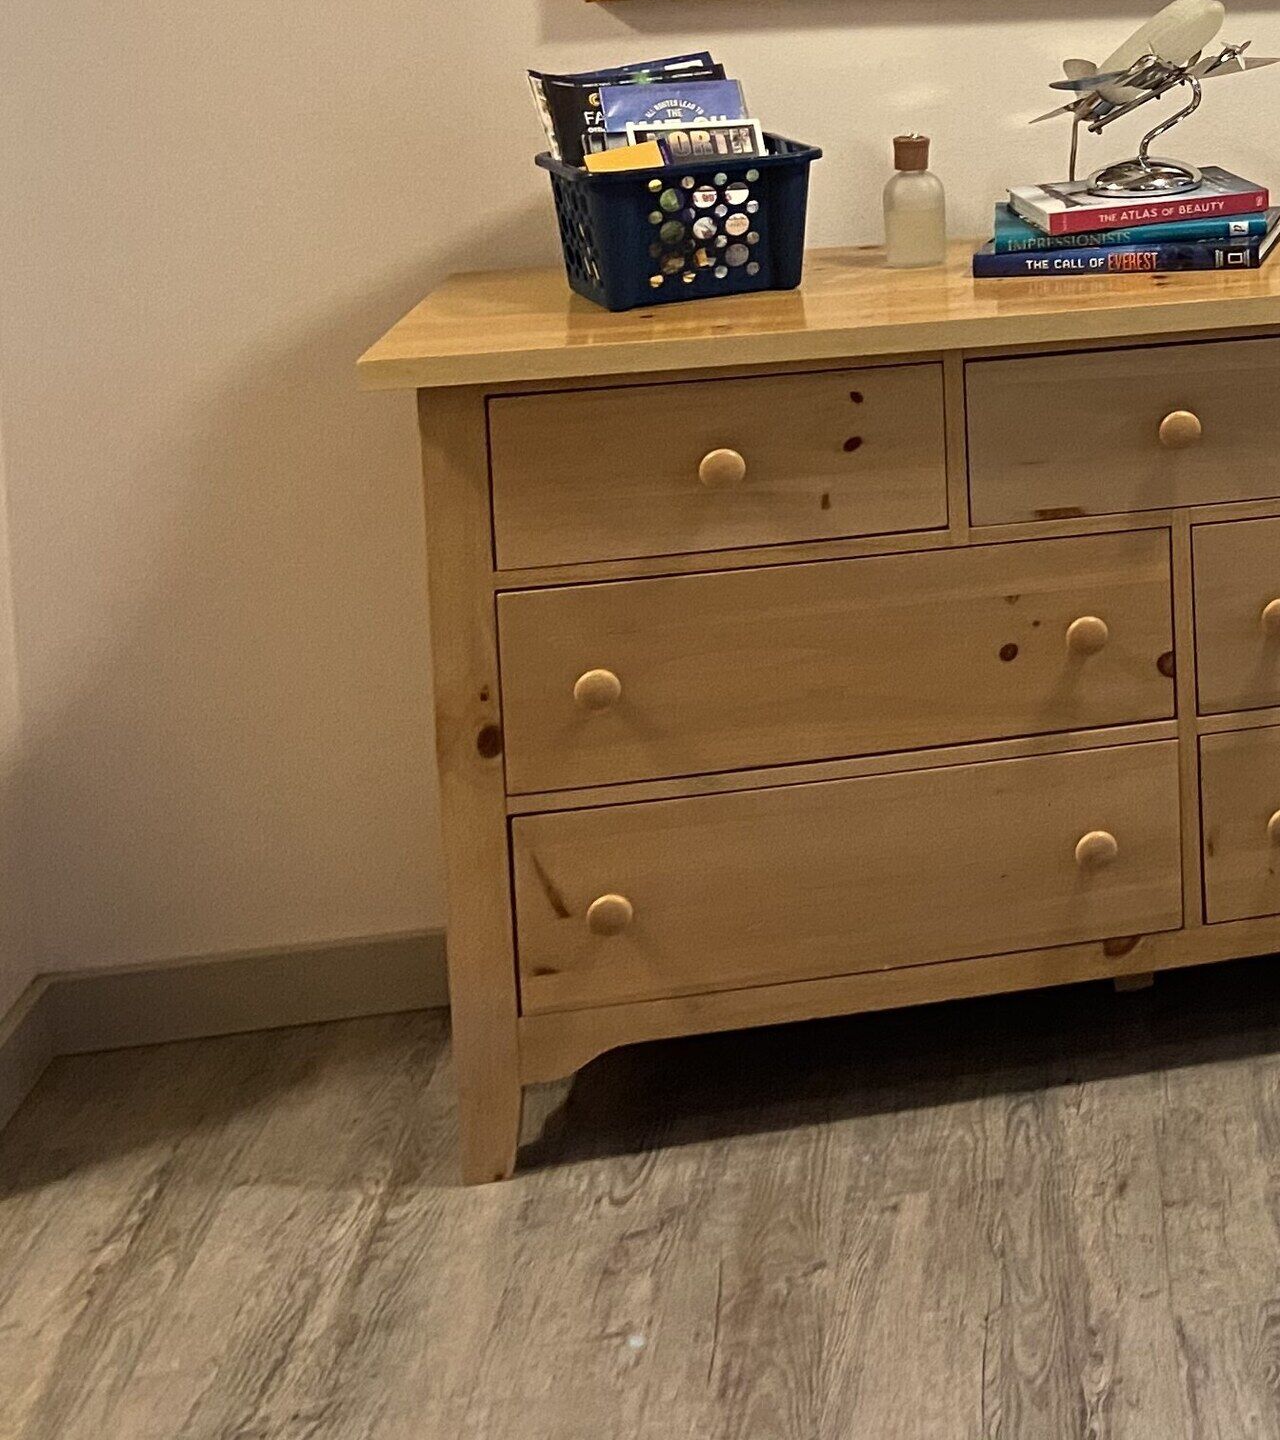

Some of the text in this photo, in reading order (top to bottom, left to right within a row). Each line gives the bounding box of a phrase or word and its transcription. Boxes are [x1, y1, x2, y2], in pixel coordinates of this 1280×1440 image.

[667, 109, 683, 118] THE
[679, 99, 696, 111] LEAD
[648, 128, 753, 156] ORTH
[1099, 201, 1225, 223] THE ATLAS OF BEAUTY
[1008, 231, 1131, 252] IMPRESSIONISTS
[1025, 252, 1159, 271] THE CALL OF EVEREST
